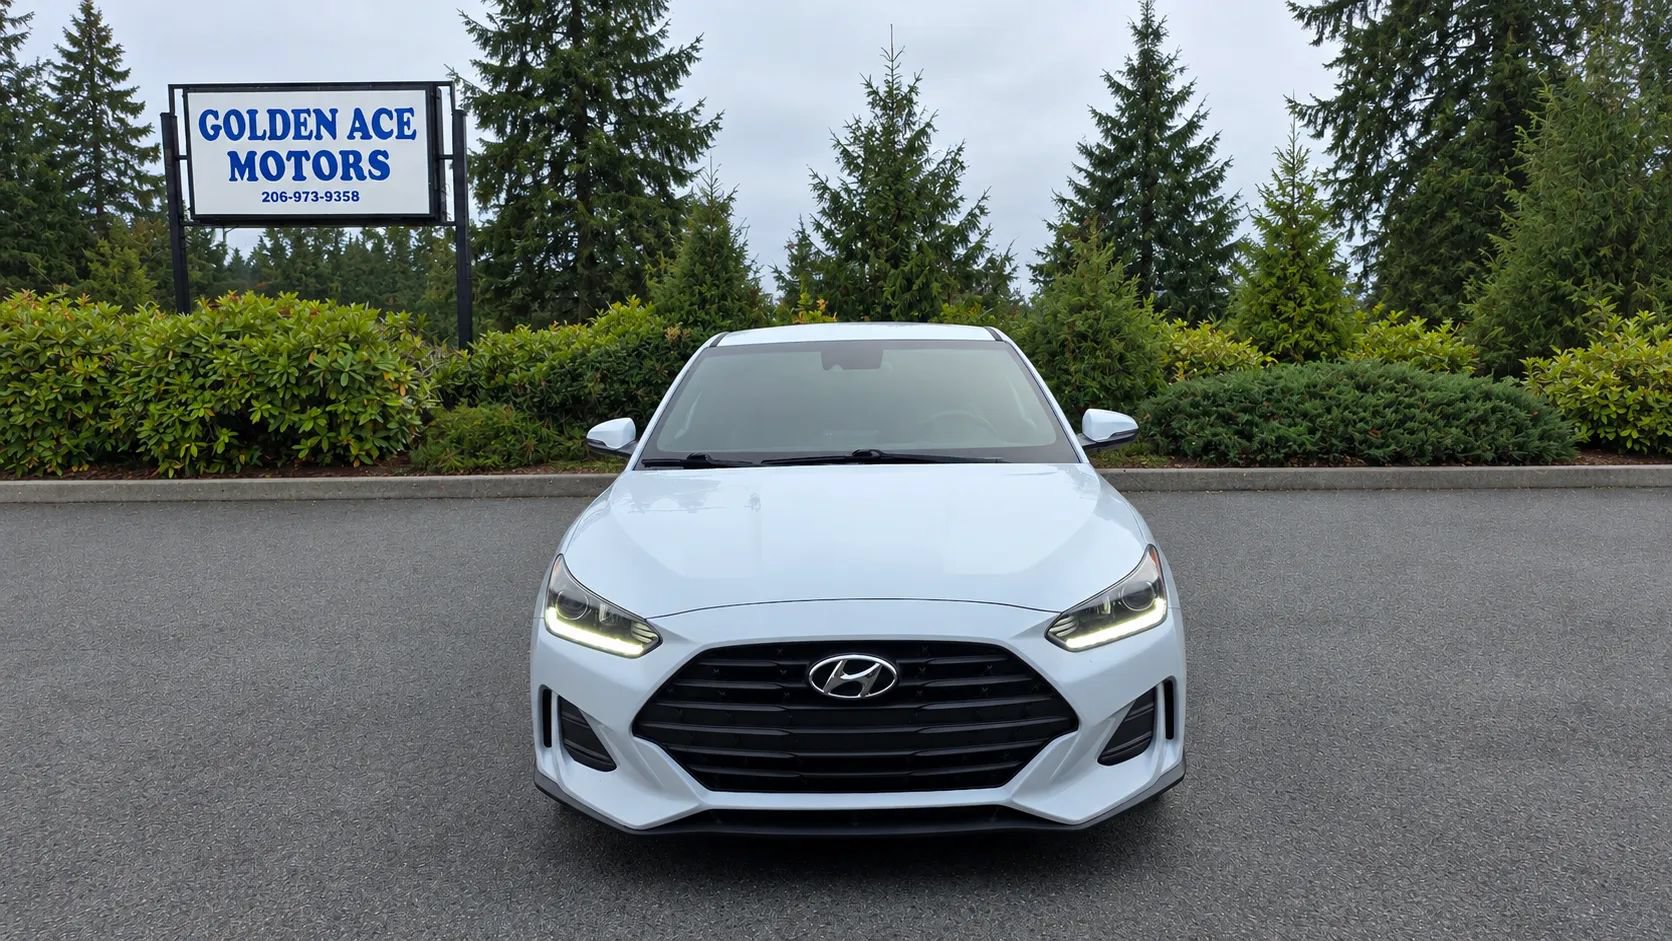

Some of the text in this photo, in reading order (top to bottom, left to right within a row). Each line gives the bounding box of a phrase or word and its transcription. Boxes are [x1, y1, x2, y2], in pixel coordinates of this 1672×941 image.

[198, 106, 418, 142] GOLDEN ACE
[227, 149, 391, 182] MOTORS
[261, 190, 361, 203] 206-973-9358
